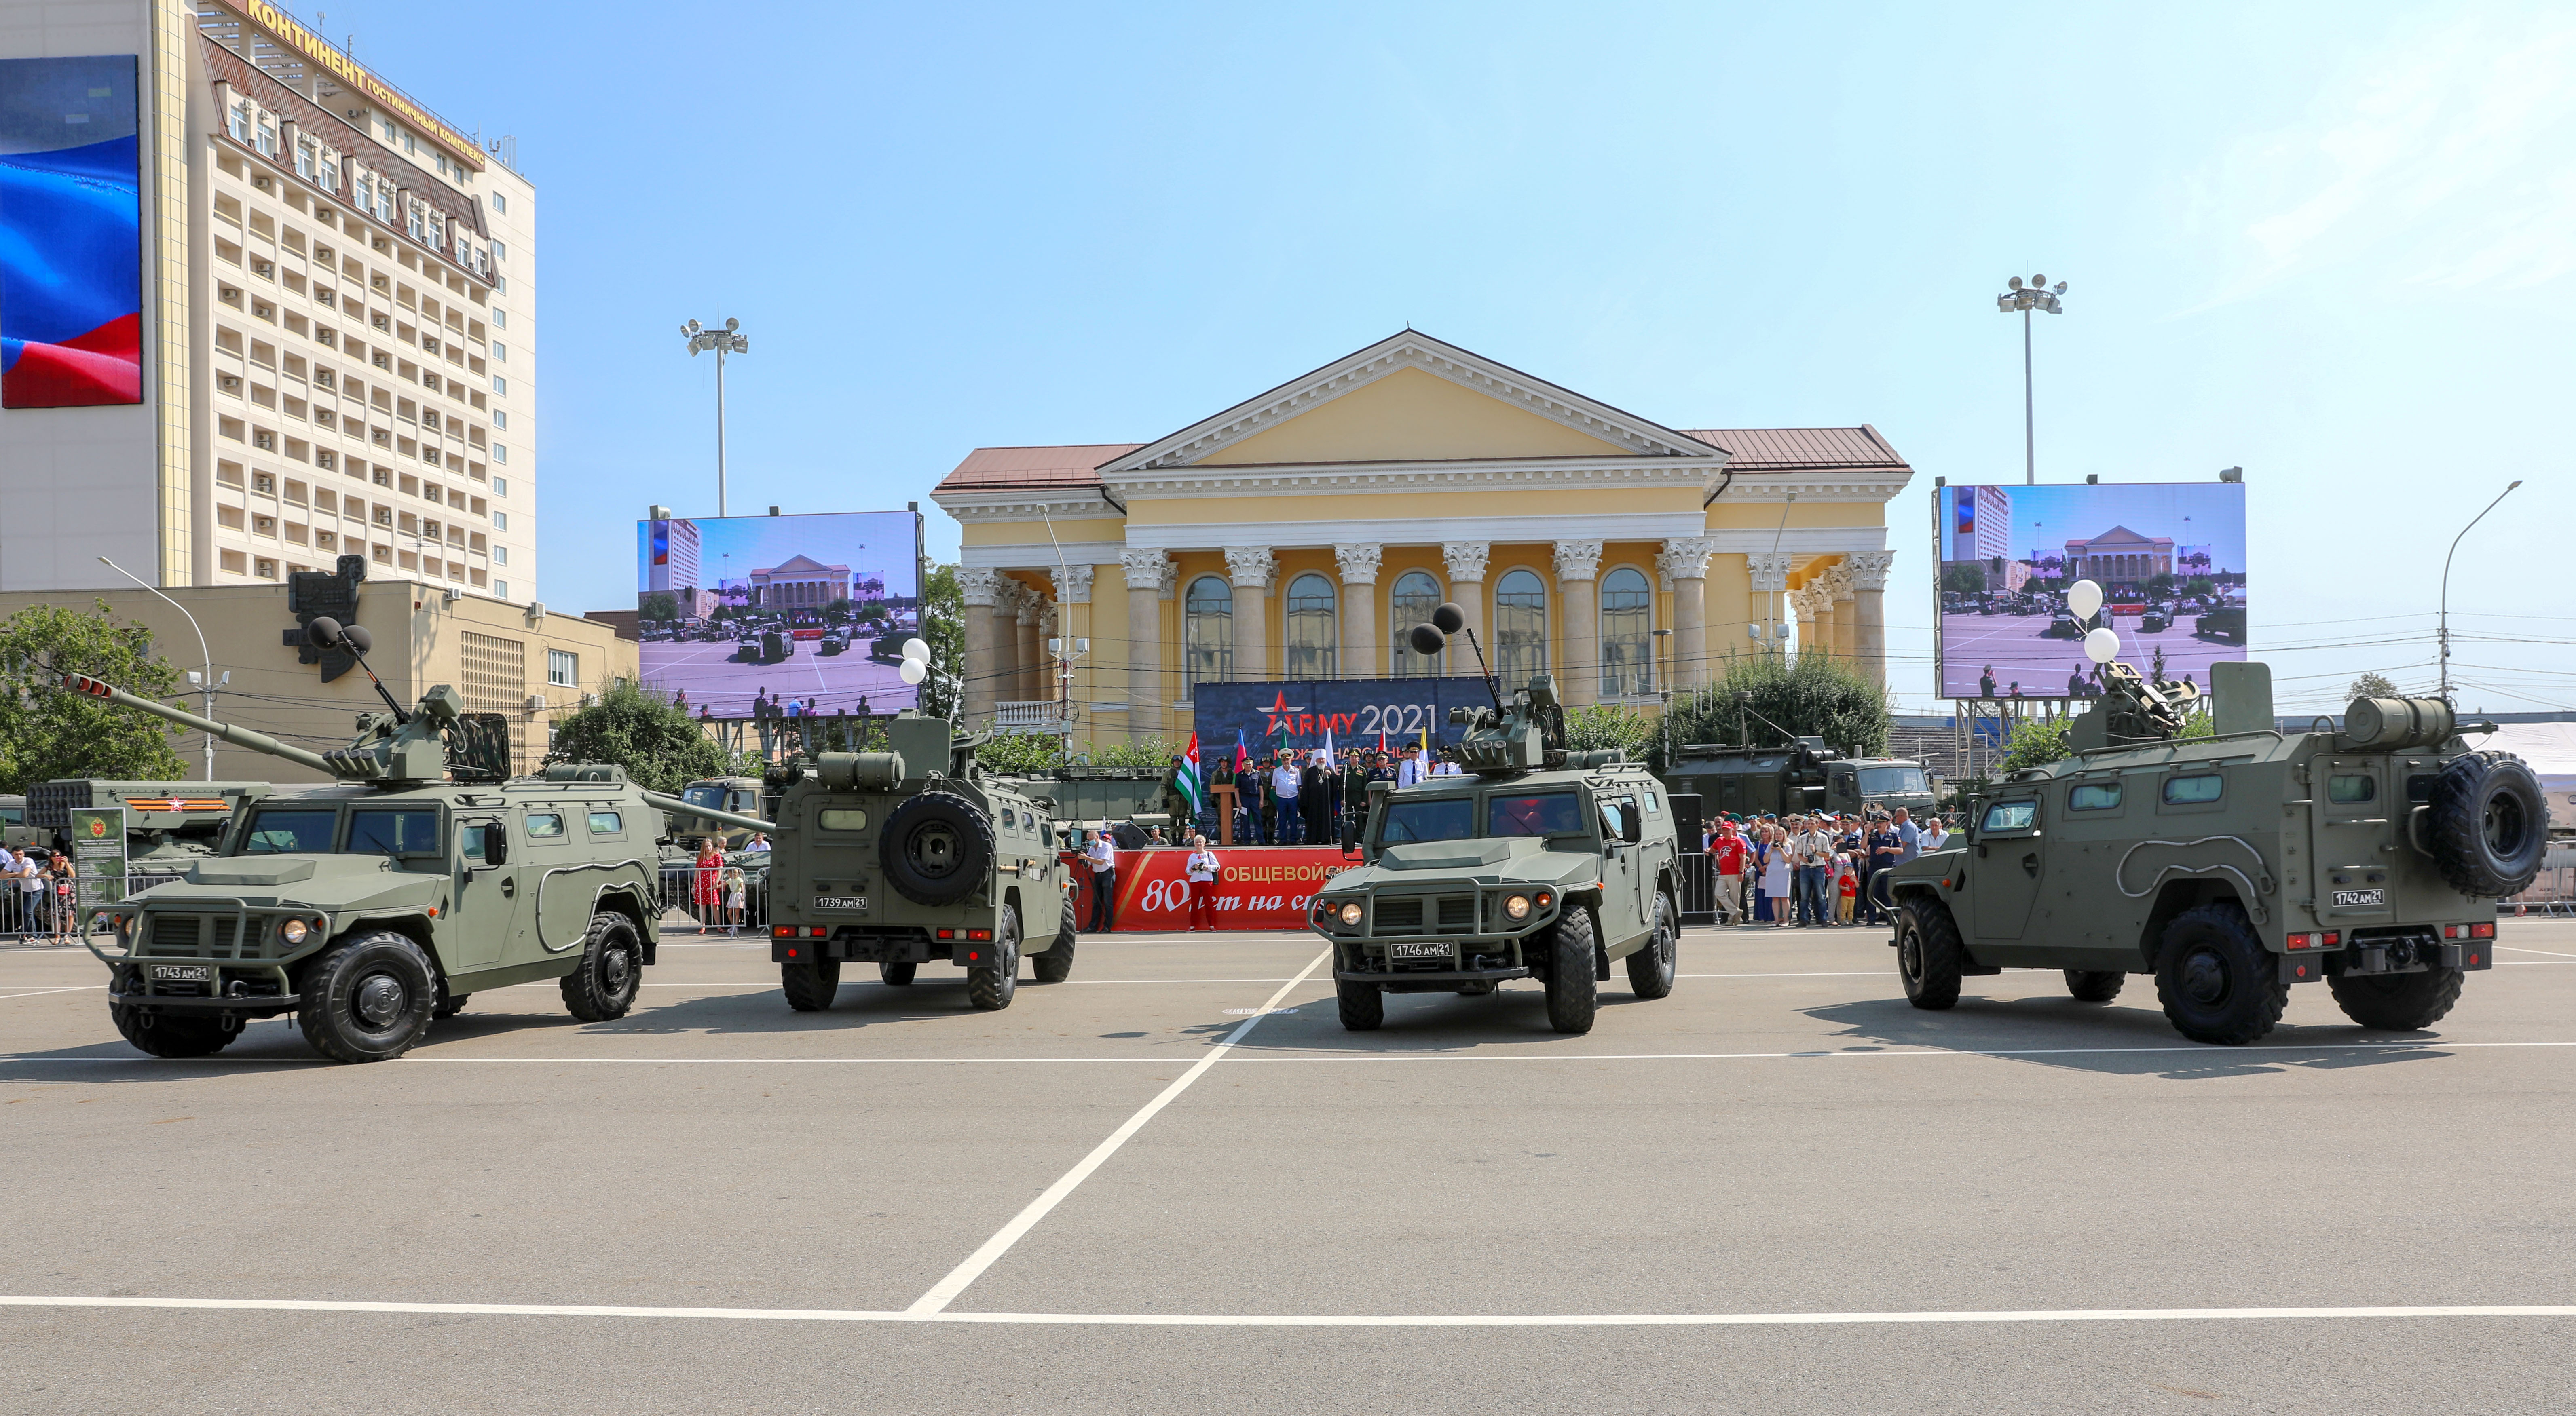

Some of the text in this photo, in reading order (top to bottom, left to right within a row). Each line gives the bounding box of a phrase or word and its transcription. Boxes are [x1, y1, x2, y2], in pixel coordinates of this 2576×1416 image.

[247, 0, 484, 165] КОНТИНЕНТ ГОСТИНИЧНЫЙ КОМПЛЕКС
[1256, 690, 1435, 736] ARMY 2021
[818, 898, 841, 907] 1739
[1141, 879, 1191, 912] 80
[1247, 896, 1284, 910] на
[2336, 892, 2358, 905] 1742
[2372, 891, 2381, 899] 21
[1396, 945, 1422, 956] 1746
[1439, 944, 1450, 952] 21
[155, 967, 180, 978] 1743
[196, 968, 207, 976] 21
